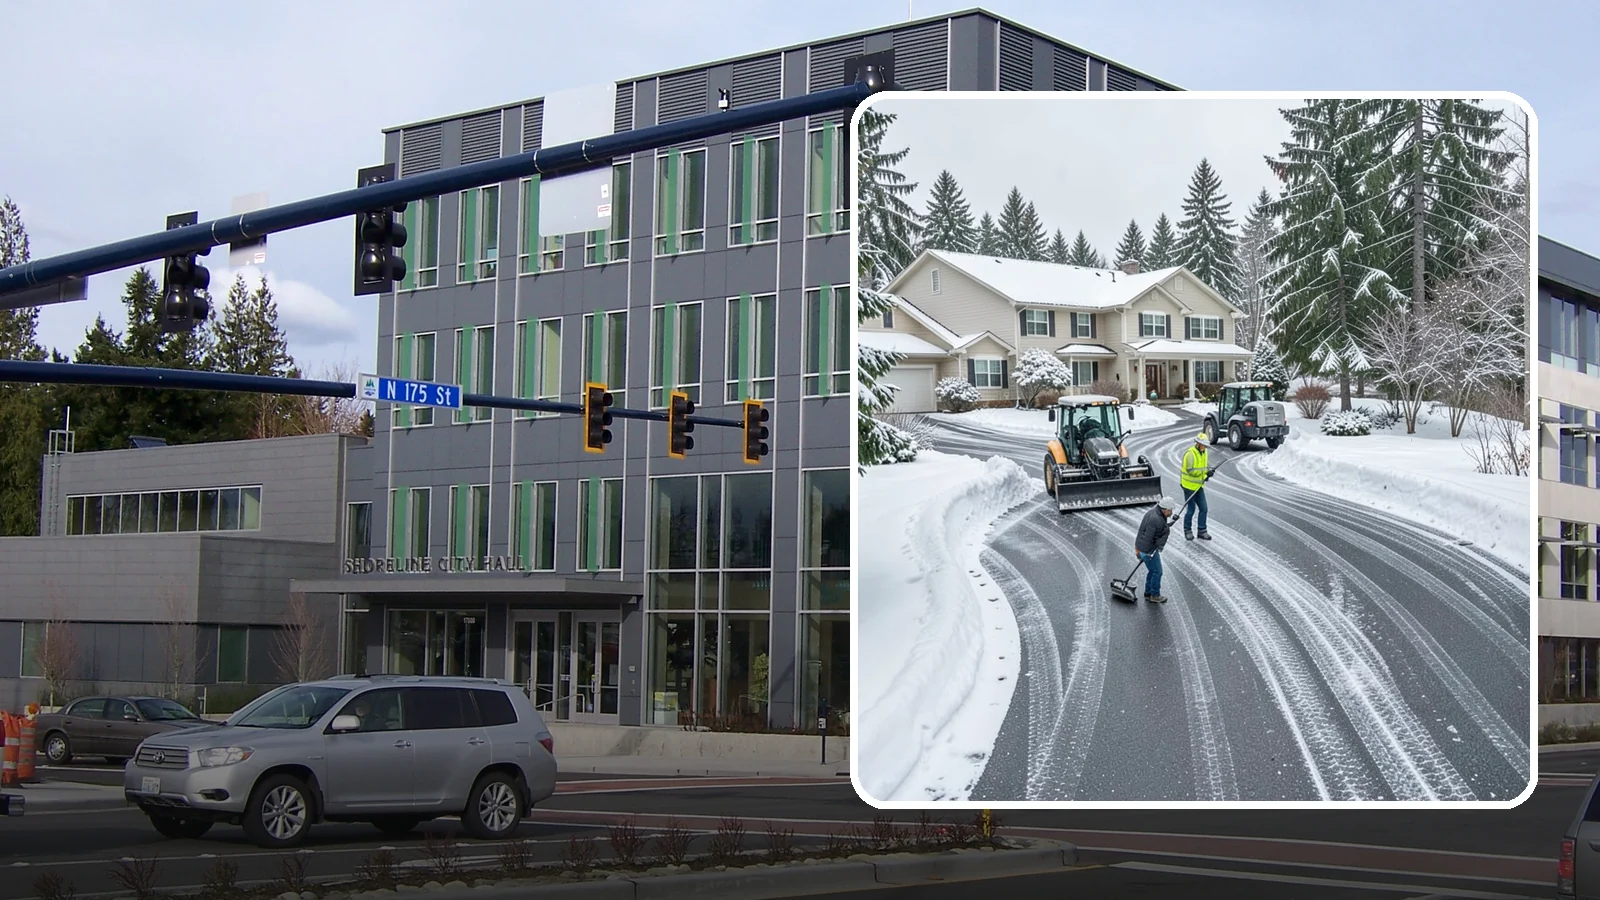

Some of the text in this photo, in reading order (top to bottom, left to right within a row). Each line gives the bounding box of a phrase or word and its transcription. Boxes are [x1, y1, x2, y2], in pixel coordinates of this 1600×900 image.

[387, 380, 451, 406] N 175 St
[344, 555, 526, 574] SHORELINE CITY HALL
